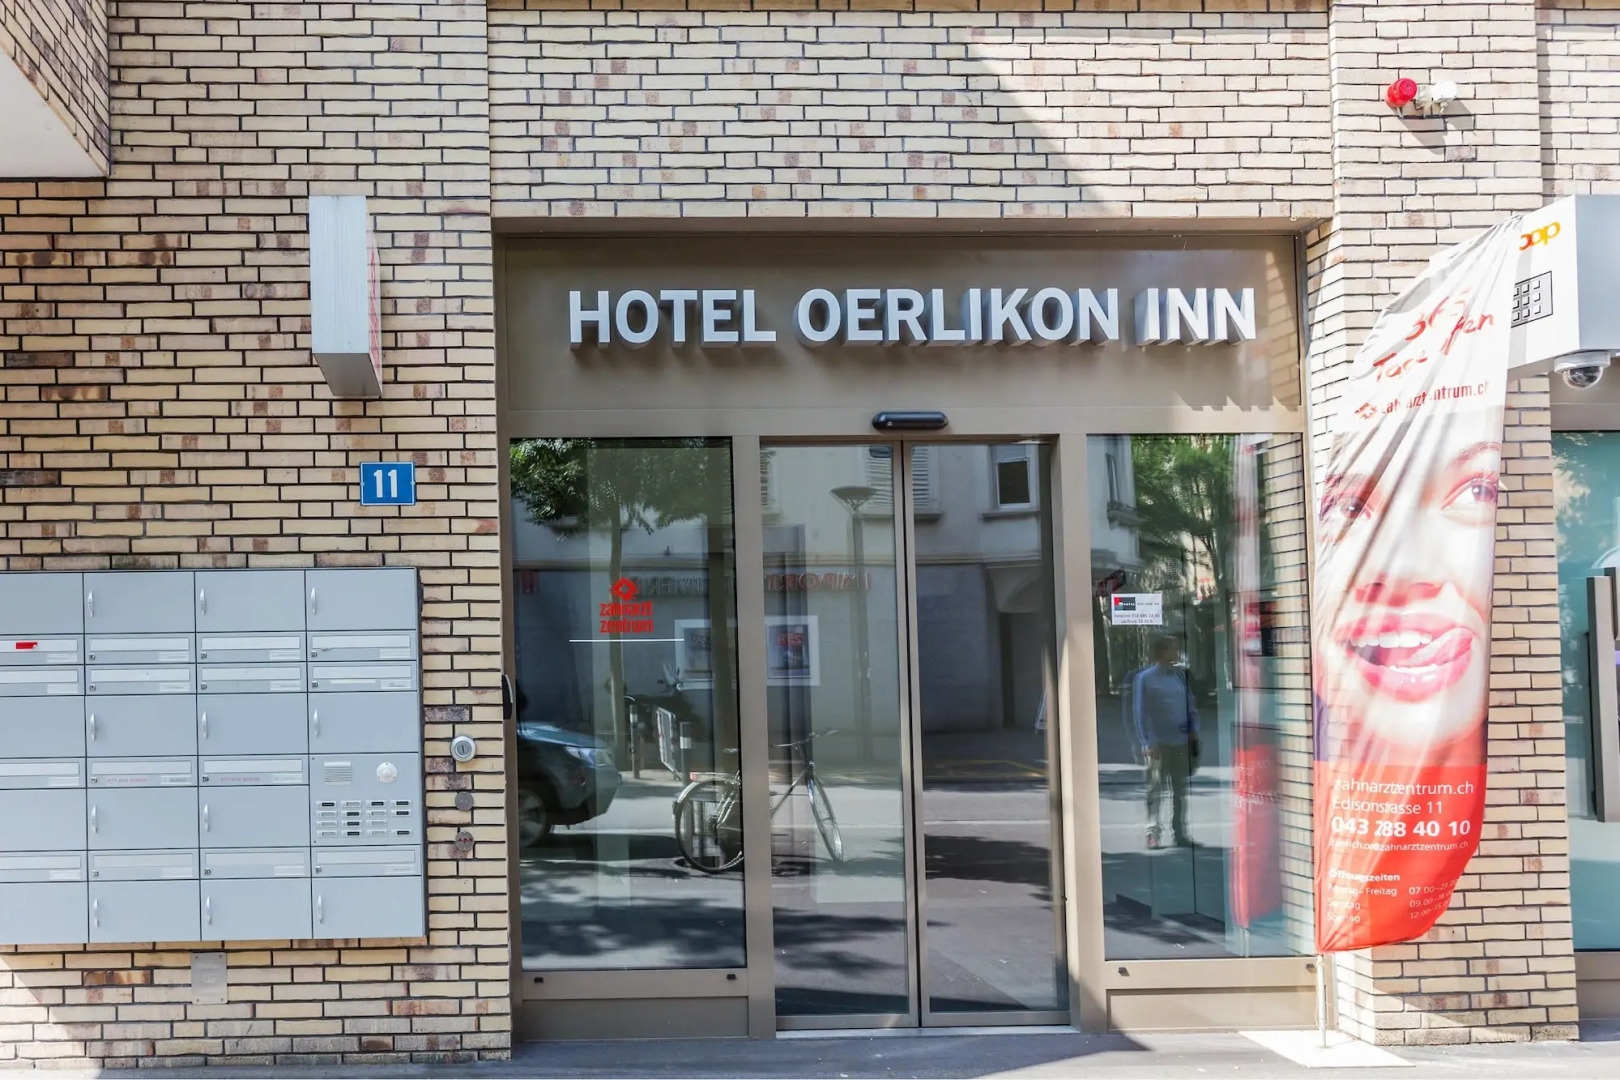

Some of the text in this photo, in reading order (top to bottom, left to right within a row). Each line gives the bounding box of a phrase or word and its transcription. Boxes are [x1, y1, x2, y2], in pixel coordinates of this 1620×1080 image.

[569, 287, 1257, 344] HOTEL OERLIKON INN
[373, 468, 399, 499] 11
[599, 602, 653, 617] zahnarzt
[599, 618, 655, 634] zentrum
[1334, 778, 1474, 796] zahnarztzentrum.ch
[1332, 796, 1442, 815] Edisonstrasse 11
[1331, 816, 1369, 835] 043
[1412, 821, 1440, 837] 40
[1448, 820, 1471, 836] 10
[1365, 887, 1398, 897] Freitag
